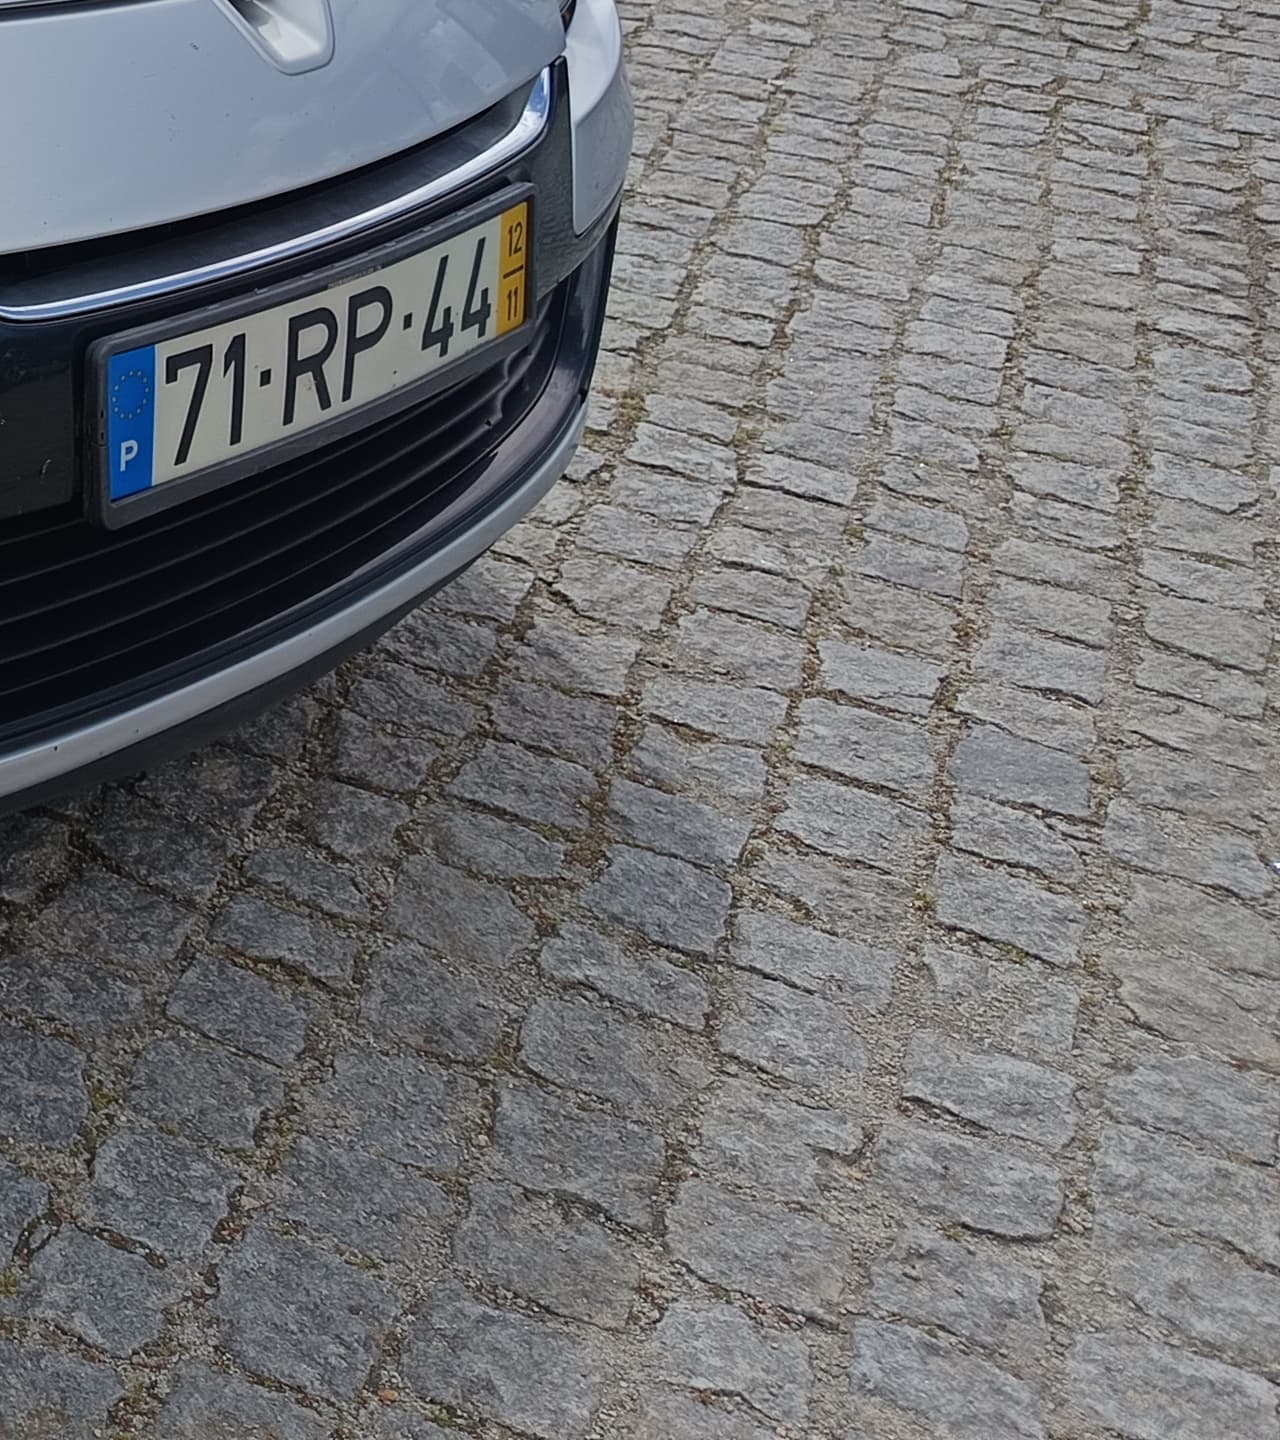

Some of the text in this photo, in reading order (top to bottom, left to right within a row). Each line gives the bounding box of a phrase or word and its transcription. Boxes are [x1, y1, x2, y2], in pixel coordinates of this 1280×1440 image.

[507, 221, 523, 257] 12
[506, 286, 519, 321] 11
[120, 439, 139, 472] P
